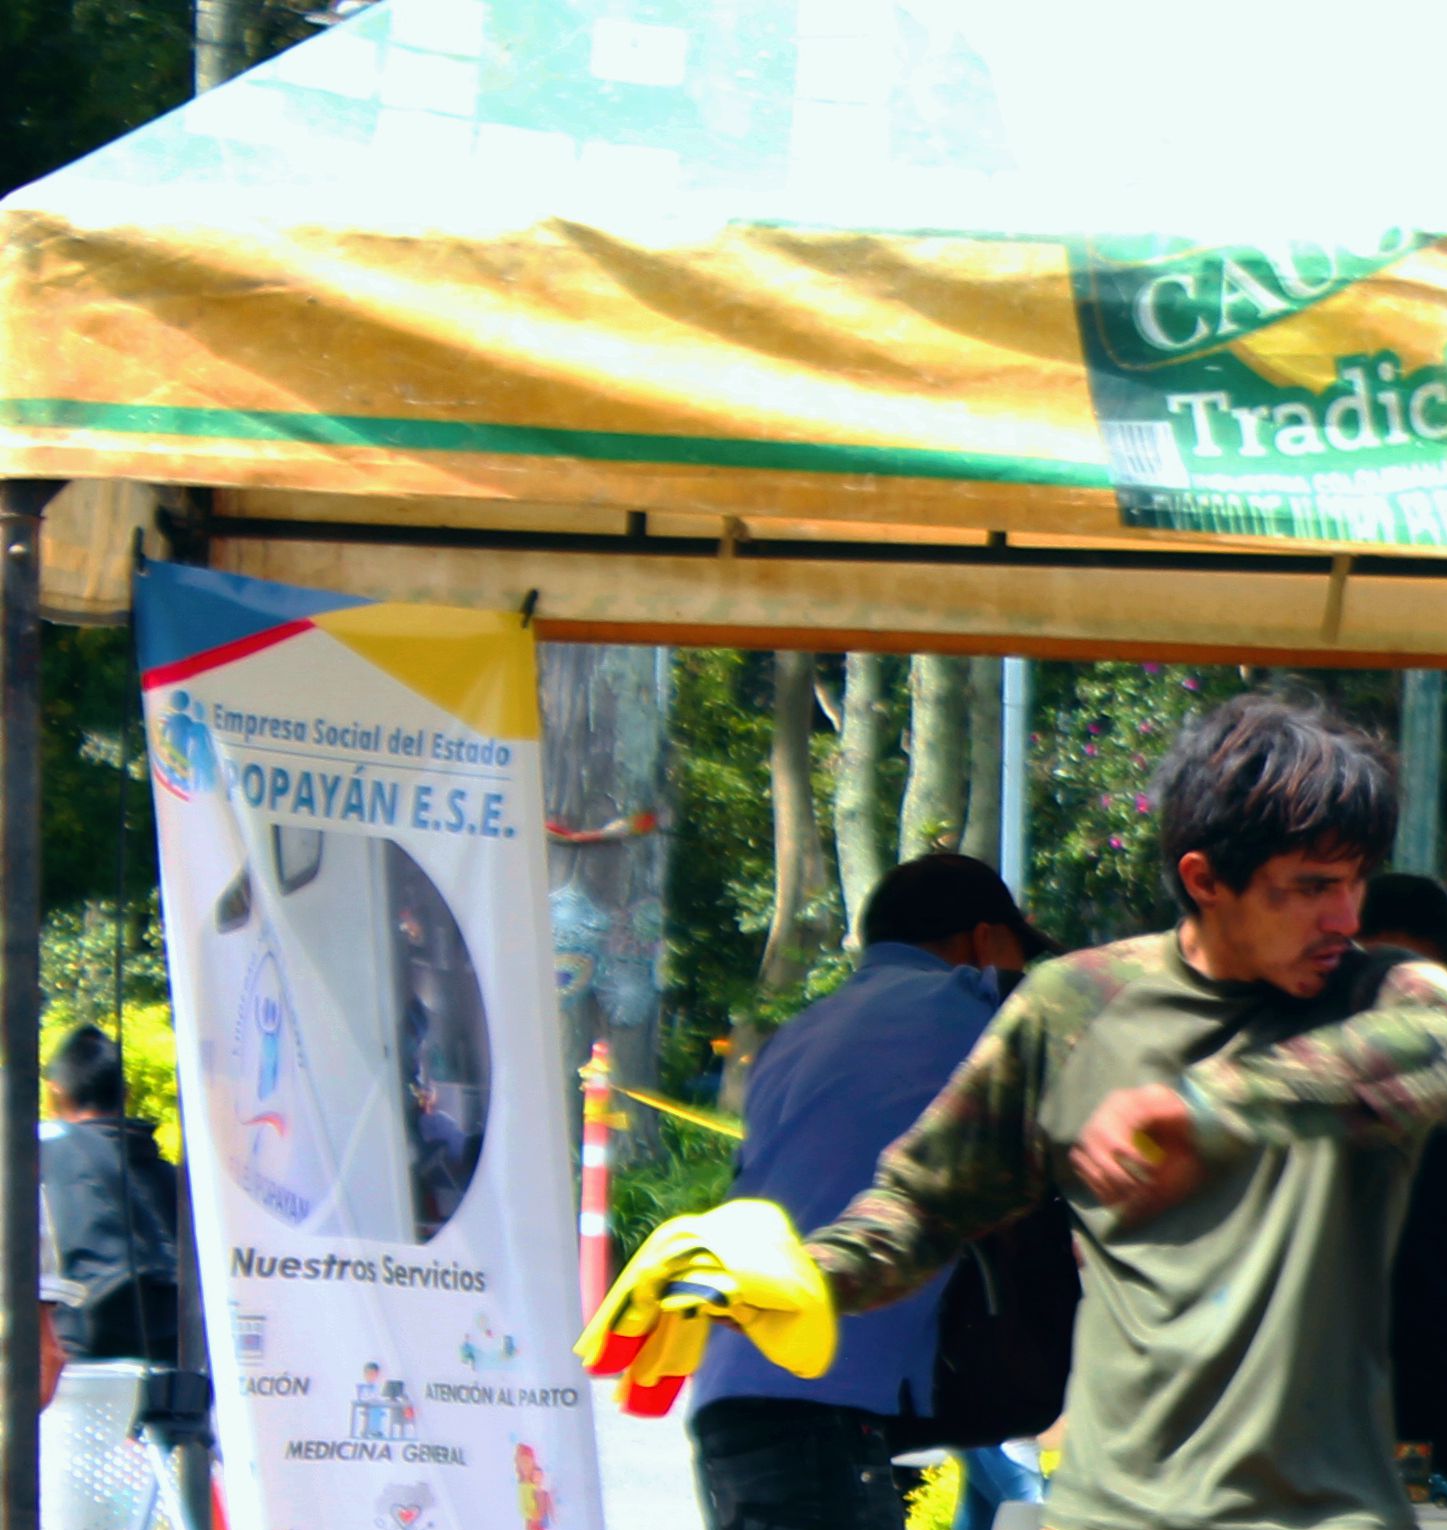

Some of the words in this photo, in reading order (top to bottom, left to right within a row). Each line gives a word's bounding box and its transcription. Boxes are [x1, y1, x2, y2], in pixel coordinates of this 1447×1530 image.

[213, 704, 306, 743] Empresa
[313, 719, 381, 752] Social
[388, 726, 423, 757] del
[431, 732, 512, 768] Estado
[411, 784, 516, 839] E.S.E.
[230, 1246, 377, 1284] Nuestros
[382, 1255, 487, 1293] Servicios
[425, 1382, 493, 1404] ATENCIÓN
[497, 1386, 516, 1406] AL
[519, 1387, 579, 1408] PARTO
[285, 1440, 392, 1463] MEDICINA
[402, 1443, 468, 1467] GENERAL
